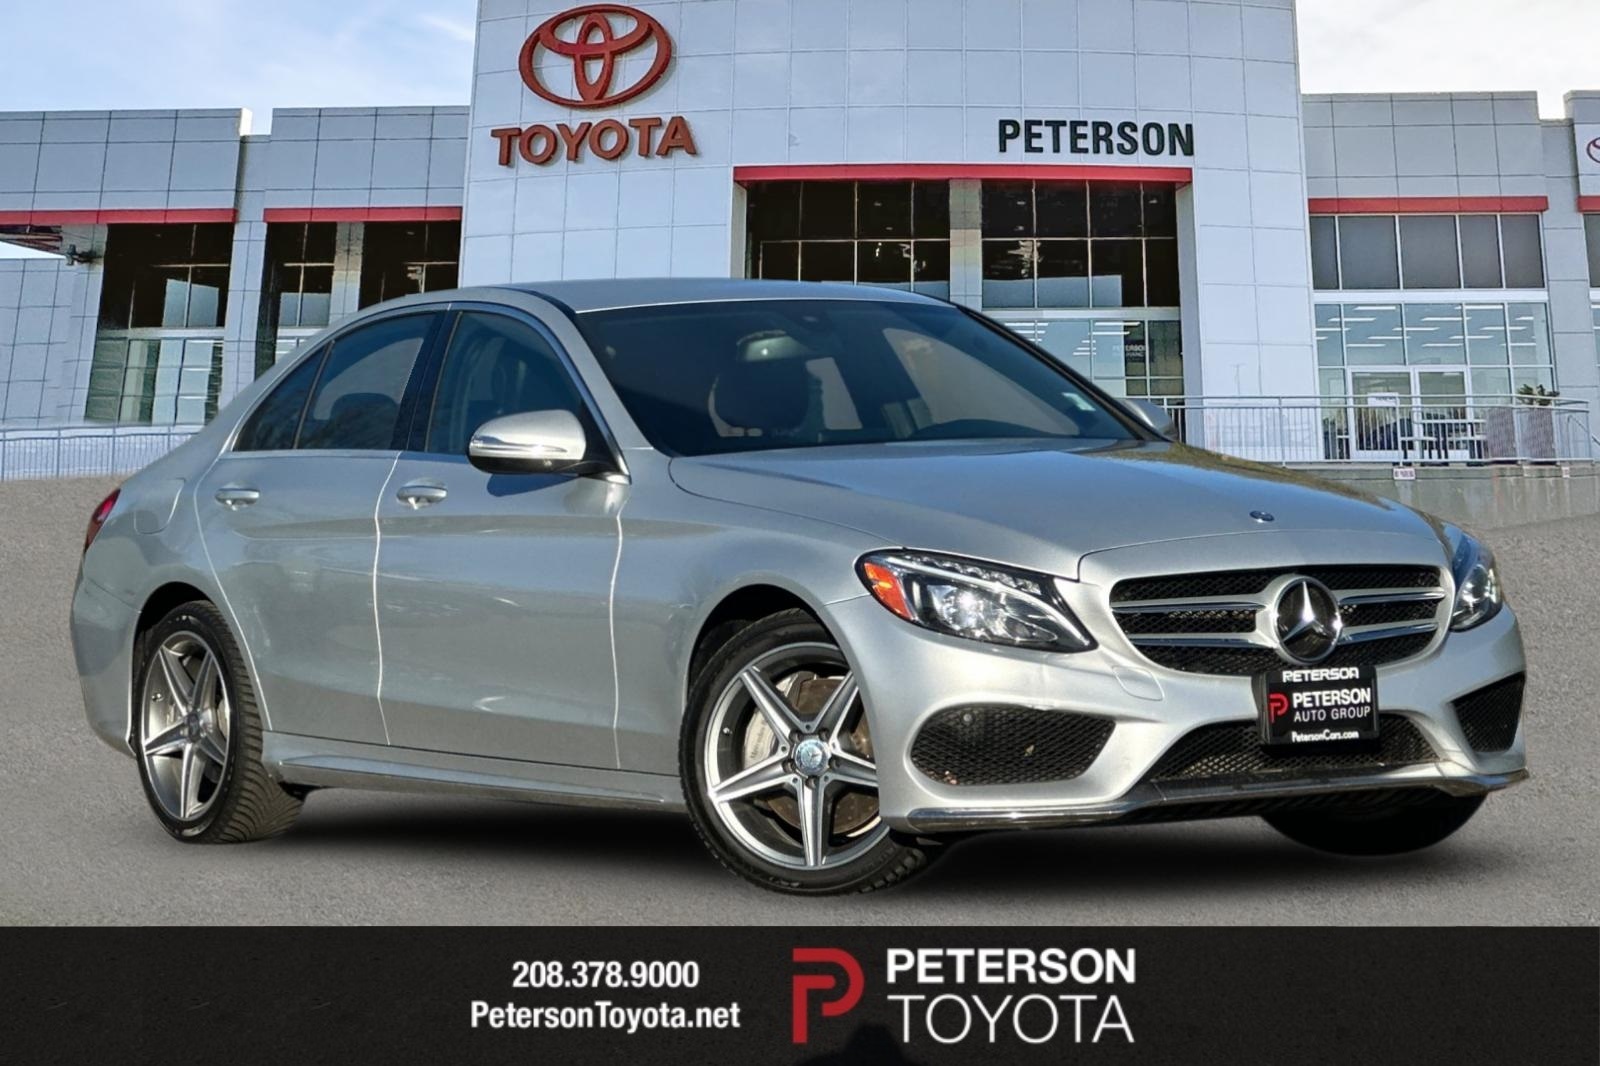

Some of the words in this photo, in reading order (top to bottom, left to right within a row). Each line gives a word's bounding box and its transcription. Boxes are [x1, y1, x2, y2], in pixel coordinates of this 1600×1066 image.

[491, 115, 697, 167] TOYOTA
[998, 119, 1195, 156] PETERSON
[1292, 687, 1371, 708] PETERSON
[1293, 709, 1327, 723] AUTO
[1330, 705, 1371, 720] GROUP
[1291, 729, 1360, 743] PetersonCars.com
